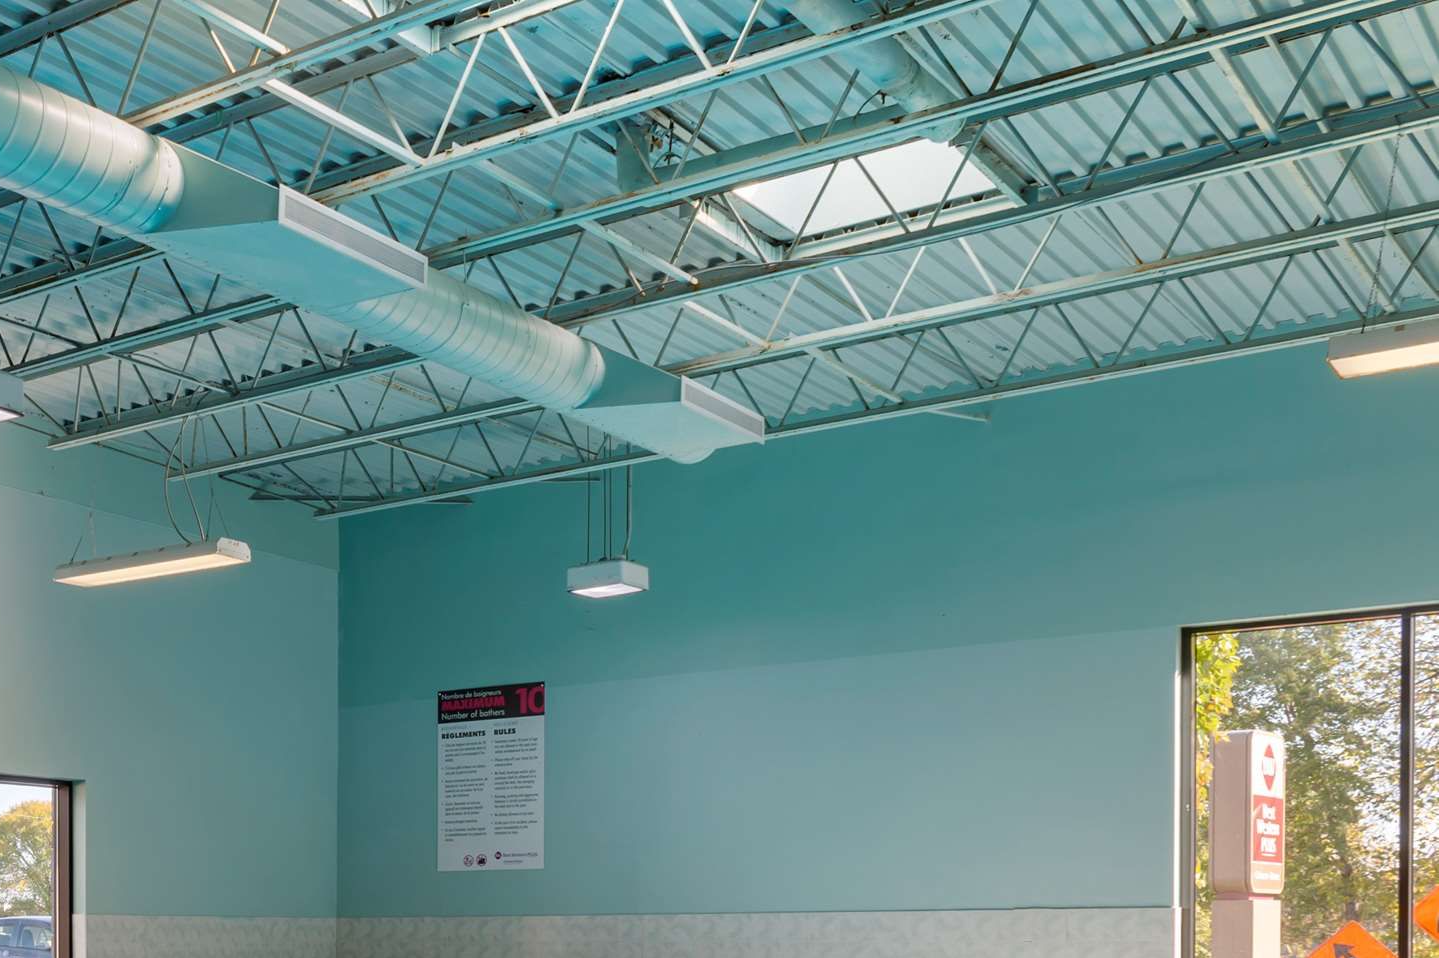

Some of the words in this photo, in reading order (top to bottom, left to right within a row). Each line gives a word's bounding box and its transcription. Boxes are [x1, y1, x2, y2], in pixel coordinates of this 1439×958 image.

[441, 692, 464, 700] Nombre
[515, 686, 544, 714] 10
[441, 711, 469, 720] Number
[470, 710, 478, 718] of
[479, 708, 505, 717] bathers
[493, 728, 516, 736] RULES
